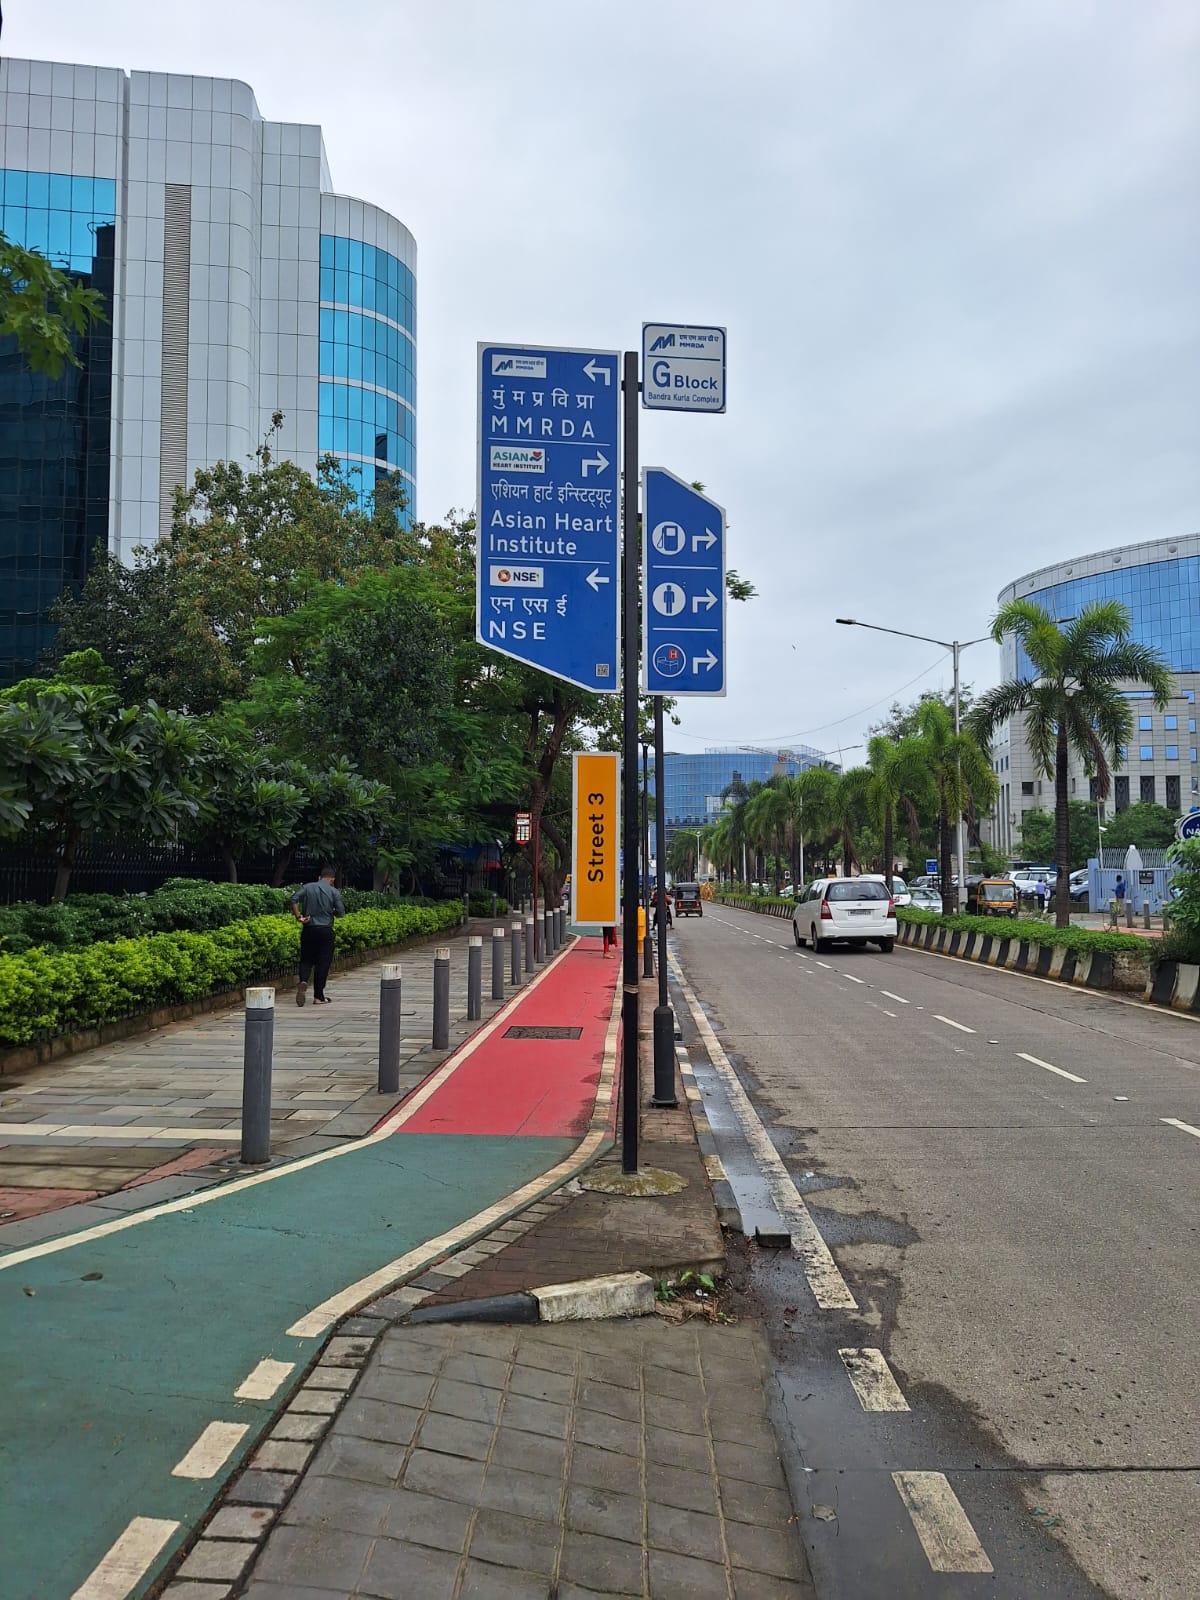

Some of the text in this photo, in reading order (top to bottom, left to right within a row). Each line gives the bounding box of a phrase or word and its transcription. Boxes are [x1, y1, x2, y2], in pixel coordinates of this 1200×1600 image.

[652, 360, 718, 390] G Block
[512, 390, 525, 405] म
[550, 387, 569, 408] वि
[648, 391, 671, 401] Bandra
[692, 394, 720, 404] Complex
[493, 451, 529, 462] ASIAN
[491, 478, 529, 501] एशियन
[533, 481, 553, 503] हार्ट
[490, 509, 612, 533] Asian Heart
[489, 534, 577, 556] Institute
[513, 571, 537, 582] NSE
[489, 593, 567, 616] एन एस ई
[489, 619, 546, 640] NSE
[588, 792, 604, 882] Street 3
